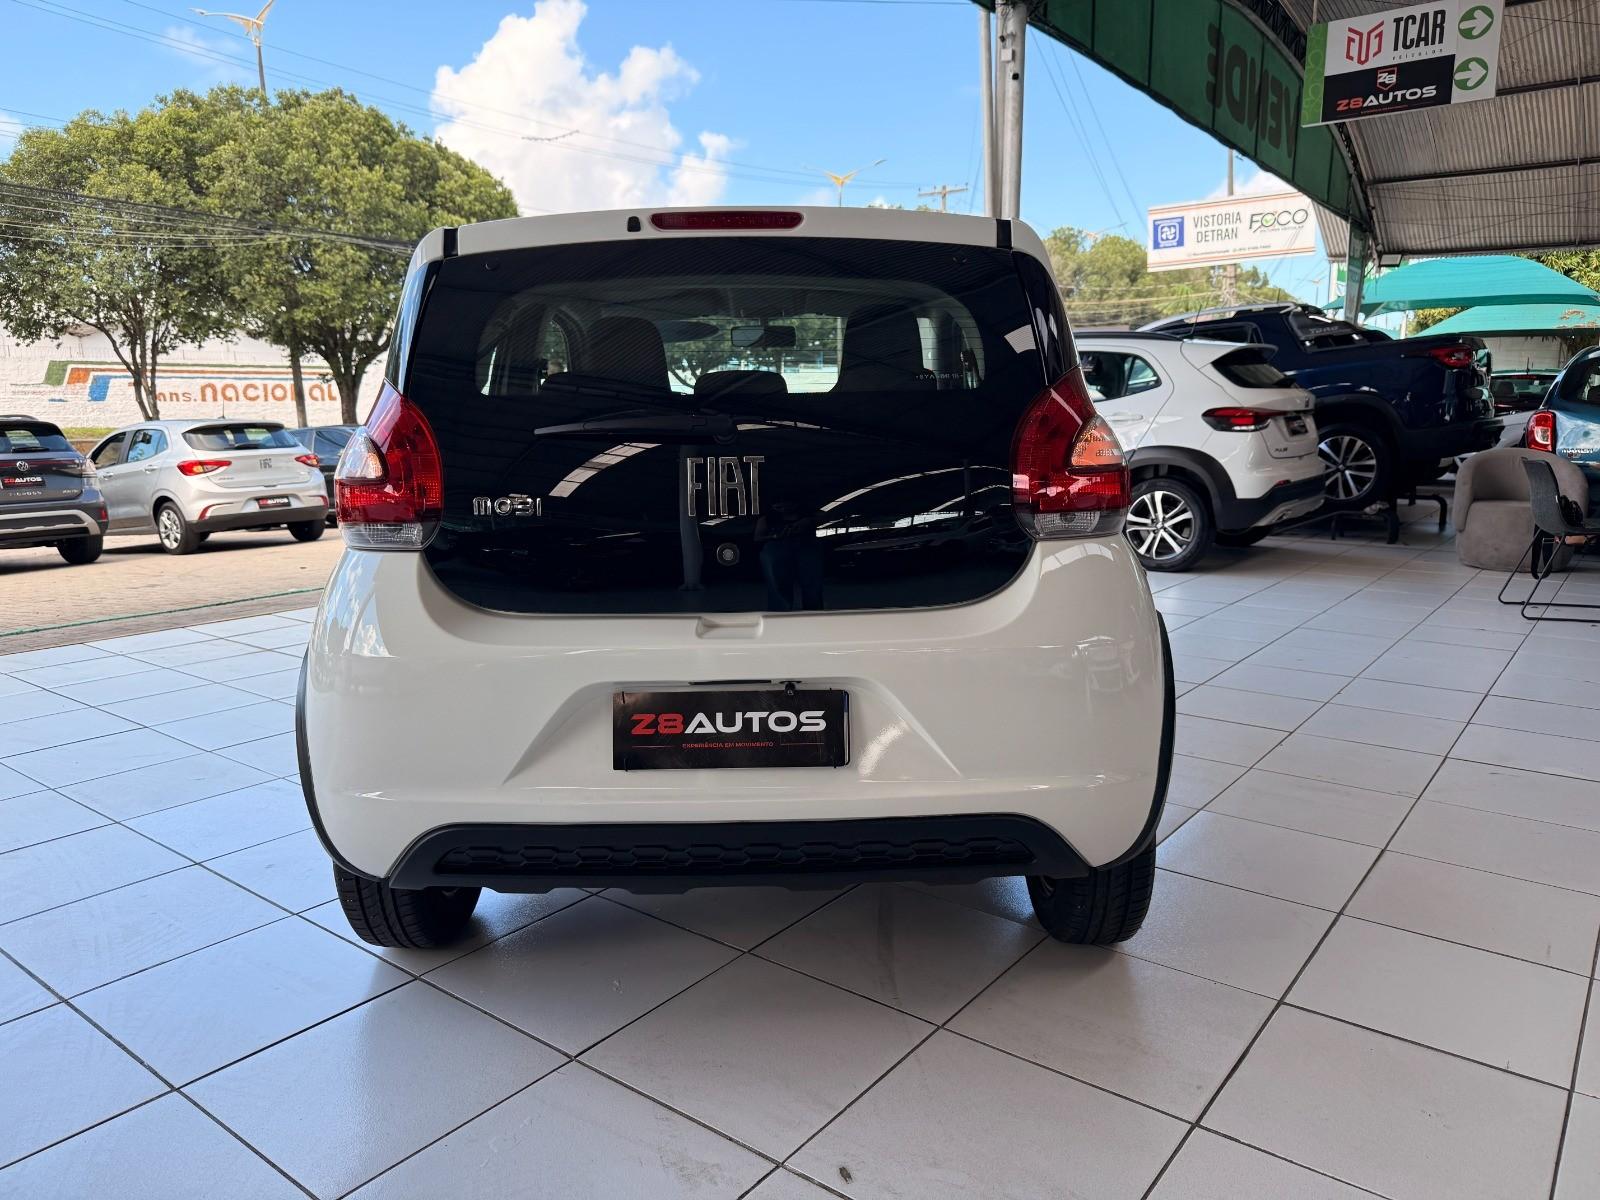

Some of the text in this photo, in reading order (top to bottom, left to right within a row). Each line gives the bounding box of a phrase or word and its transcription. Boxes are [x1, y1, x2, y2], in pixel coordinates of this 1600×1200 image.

[1393, 9, 1446, 52] TCAR
[1336, 85, 1437, 111] Z8AUTOS
[1193, 211, 1242, 229] VISTORIA
[1249, 208, 1309, 233] FOCO
[1196, 227, 1238, 243] DETRAN
[687, 455, 765, 517] FIAT
[630, 710, 827, 735] Z8AUTOS
